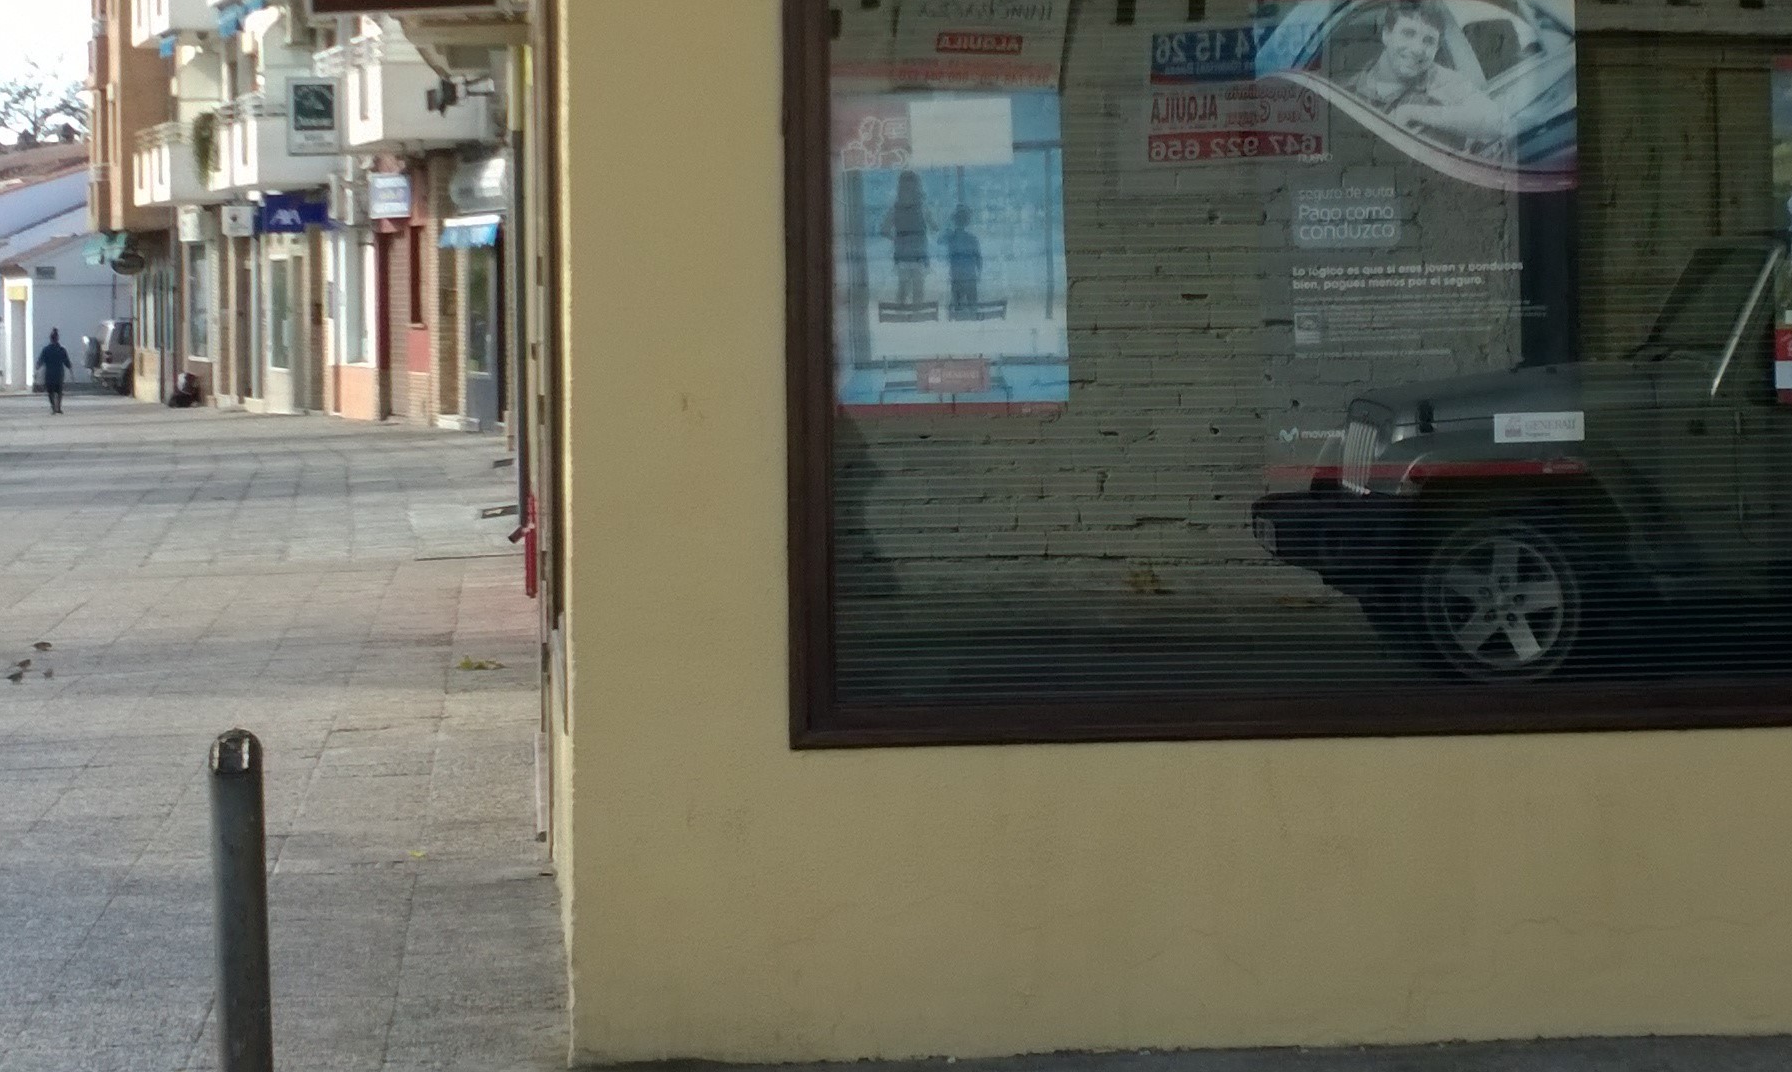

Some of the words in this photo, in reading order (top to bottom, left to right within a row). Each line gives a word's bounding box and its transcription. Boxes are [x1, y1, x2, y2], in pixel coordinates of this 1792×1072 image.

[1298, 188, 1343, 203] seguro
[1345, 187, 1361, 199] de
[1364, 187, 1395, 199] auto
[1298, 205, 1342, 224] Pago
[1346, 205, 1395, 220] como
[1299, 222, 1395, 241] conduzco
[1308, 265, 1344, 280] lógico
[1346, 267, 1360, 276] es
[1363, 266, 1384, 278] que
[1398, 264, 1422, 274] eres
[1423, 262, 1455, 276] joven
[1468, 260, 1524, 272] conduces
[1323, 279, 1366, 292] pagues
[1368, 277, 1406, 288] menos
[1408, 278, 1428, 289] por
[1430, 275, 1441, 286] el
[1443, 276, 1486, 289] seguro.
